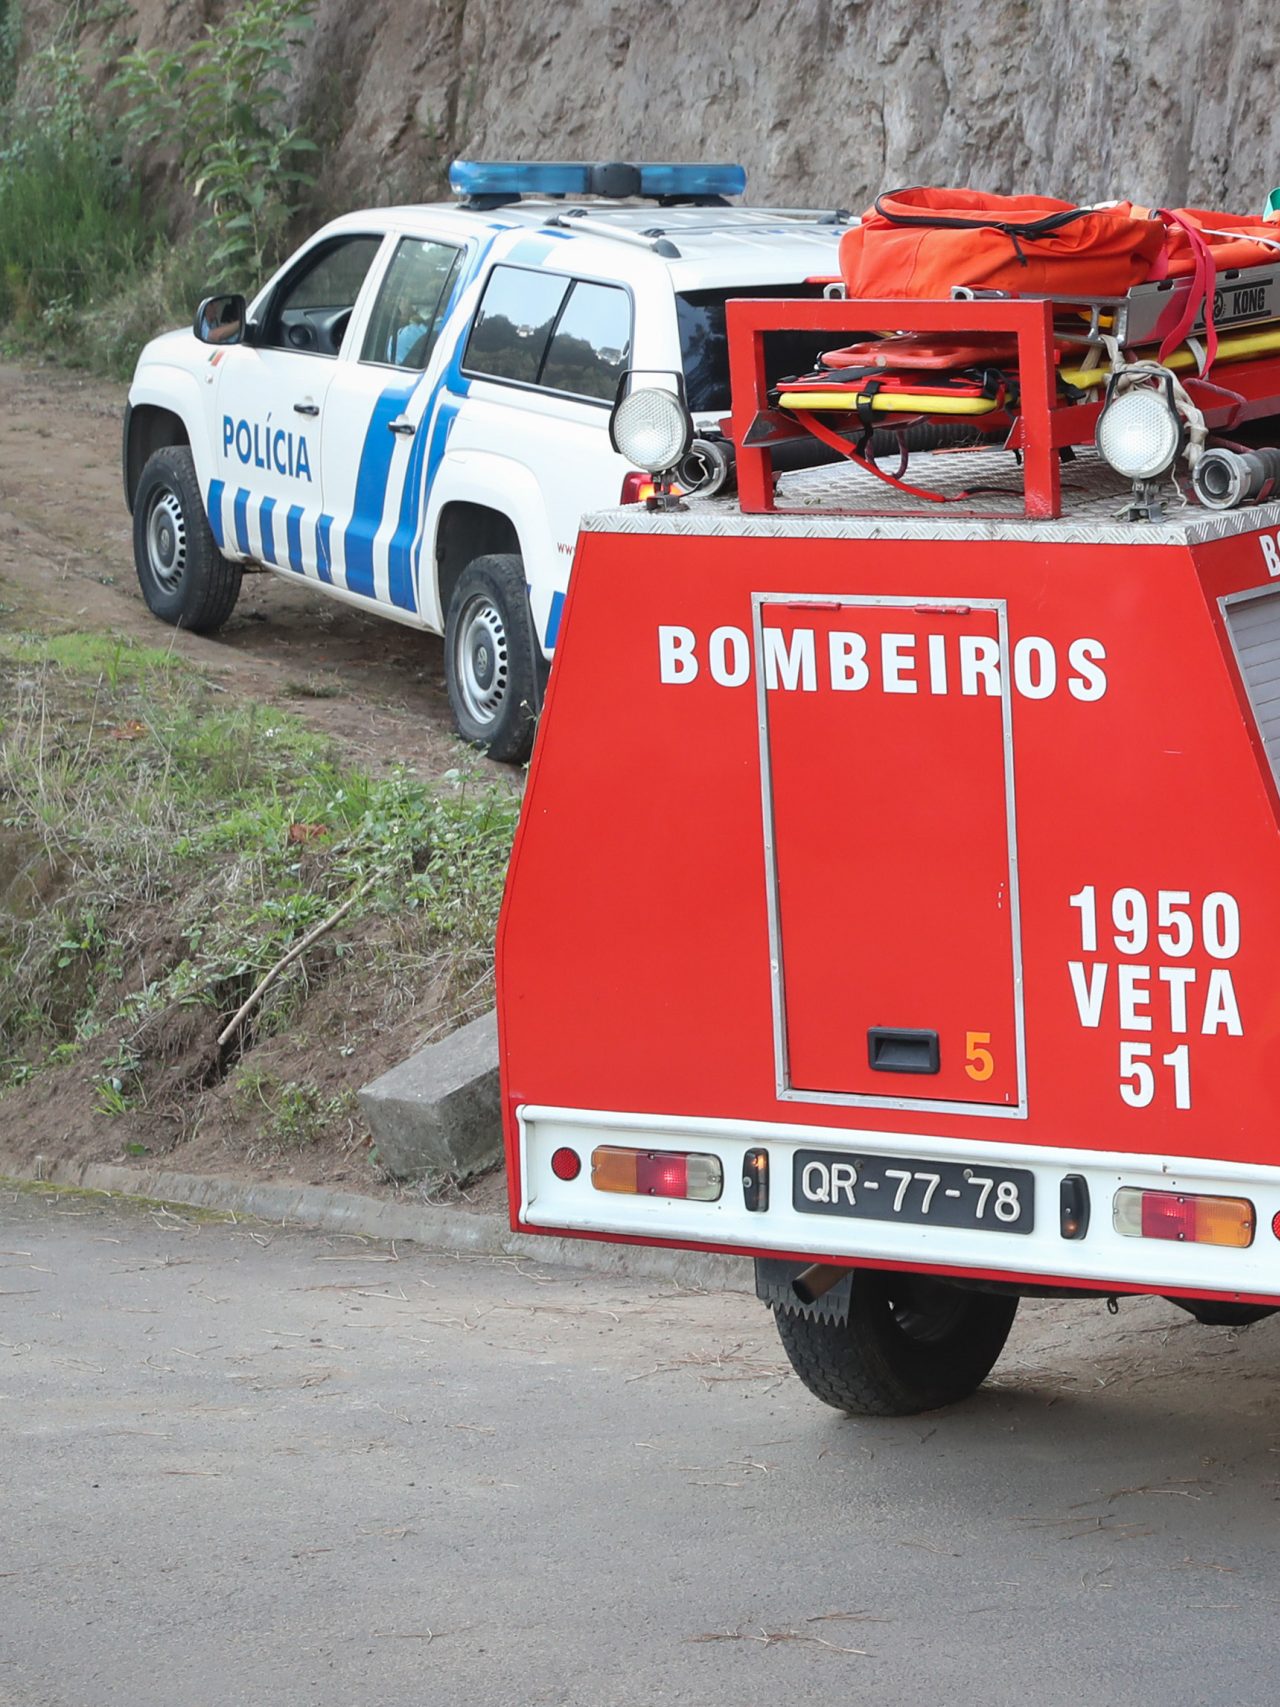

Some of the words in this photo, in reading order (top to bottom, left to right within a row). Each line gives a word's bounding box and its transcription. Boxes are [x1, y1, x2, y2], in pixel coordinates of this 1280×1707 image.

[1233, 287, 1266, 316] KONG
[222, 411, 313, 483] POLÍCIA
[657, 624, 1109, 702] BOMBEIROS
[1069, 885, 1240, 959] 1950
[1067, 960, 1244, 1036] VETA
[964, 1031, 994, 1082] 5
[1119, 1041, 1192, 1110] 51
[801, 1161, 1022, 1223] QR-77-78
